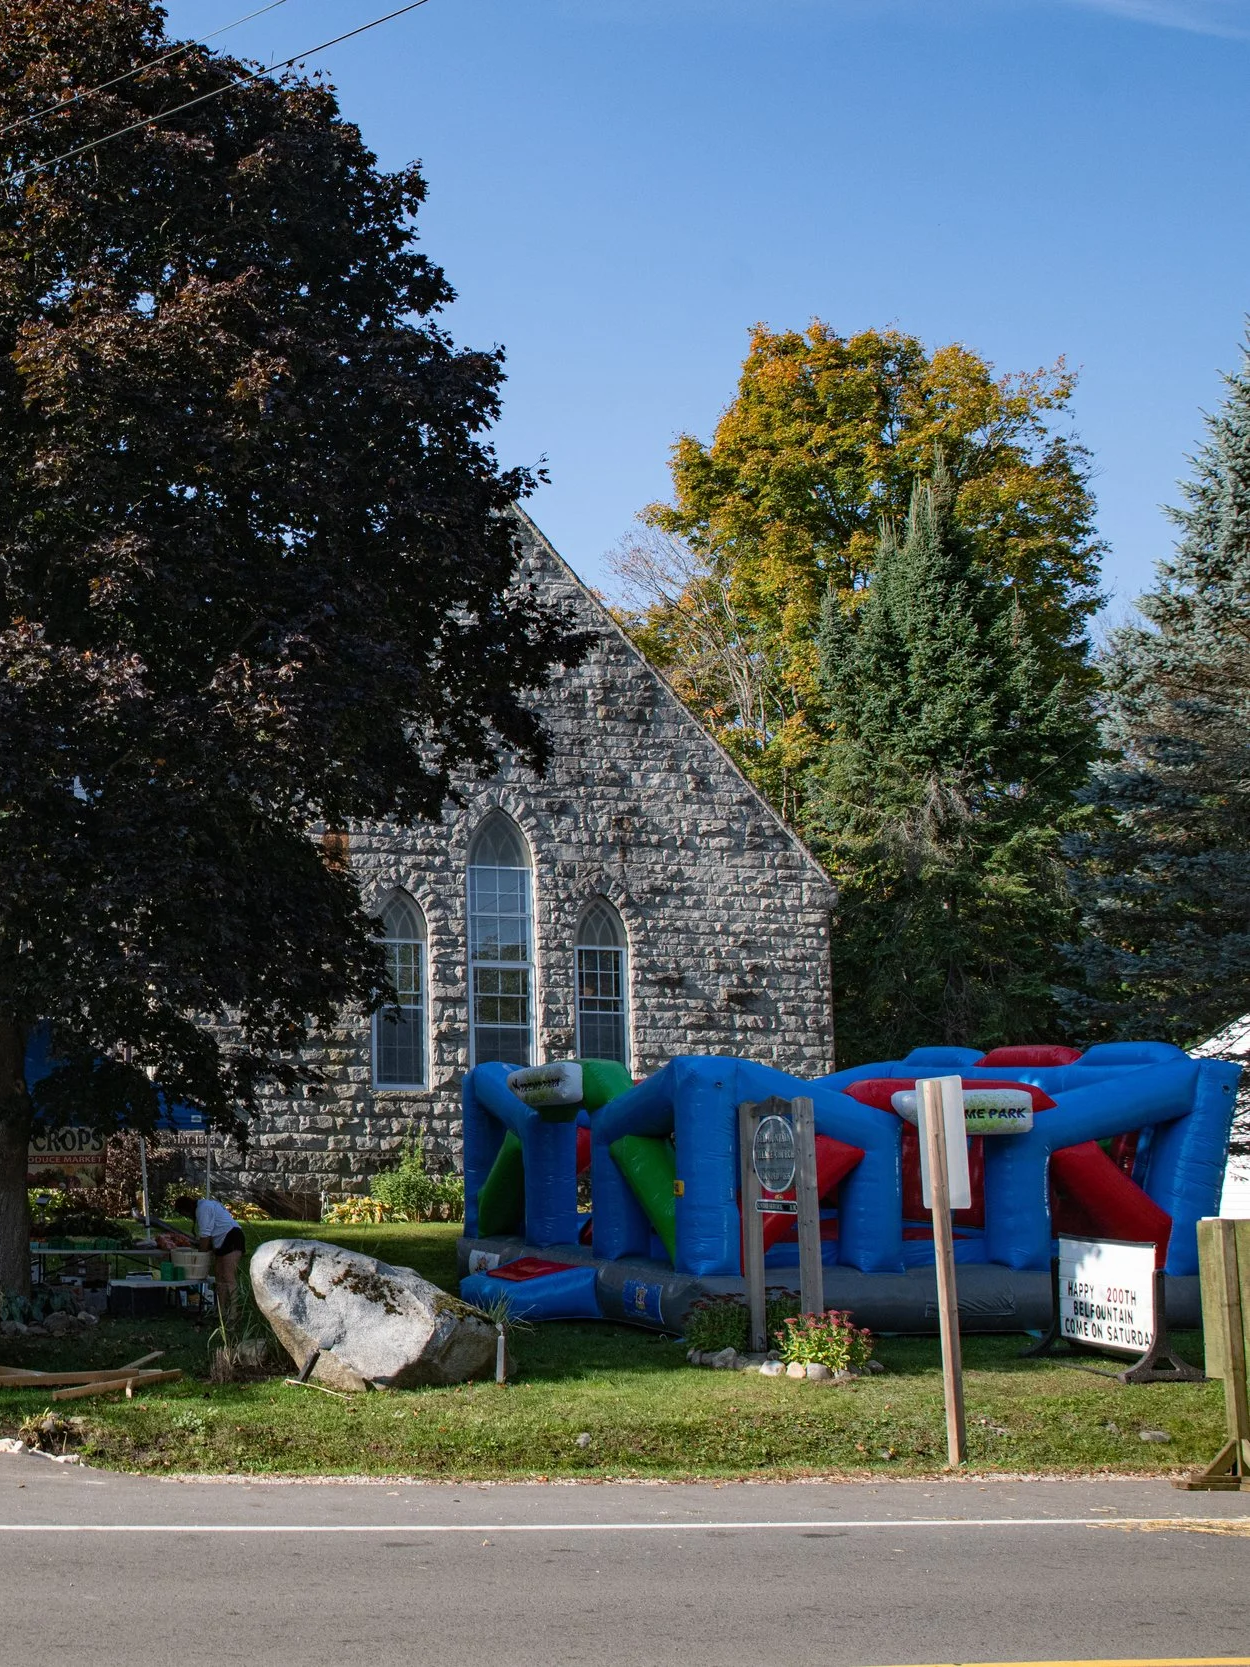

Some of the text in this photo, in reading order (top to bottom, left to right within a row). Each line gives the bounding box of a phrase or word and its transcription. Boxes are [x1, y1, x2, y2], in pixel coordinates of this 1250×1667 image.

[988, 1107, 1026, 1119] PARK
[32, 1128, 104, 1151] CROPS
[27, 1155, 102, 1164] ODUCE MARKET
[1068, 1282, 1136, 1306] HAPPY 200TH
[1074, 1301, 1133, 1324] BELFOUNTAIN
[1065, 1318, 1088, 1336] COME
[1091, 1322, 1103, 1338] ON
